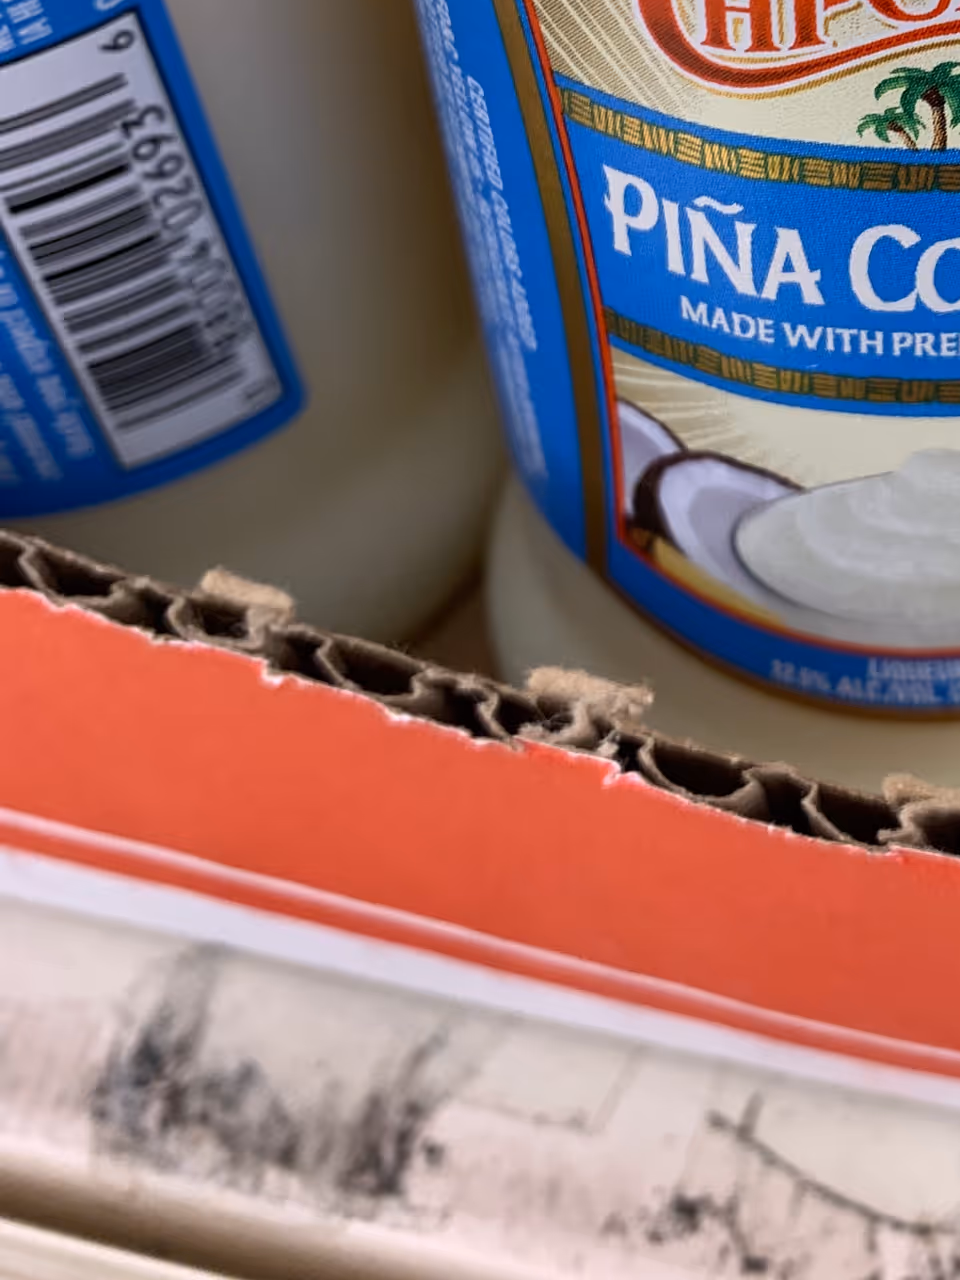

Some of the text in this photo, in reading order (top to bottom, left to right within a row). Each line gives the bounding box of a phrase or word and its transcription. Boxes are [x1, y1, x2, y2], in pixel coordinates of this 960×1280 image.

[98, 28, 136, 54] 6
[602, 163, 822, 307] PIÑA
[680, 294, 775, 346] MADE
[782, 321, 886, 357] WITH
